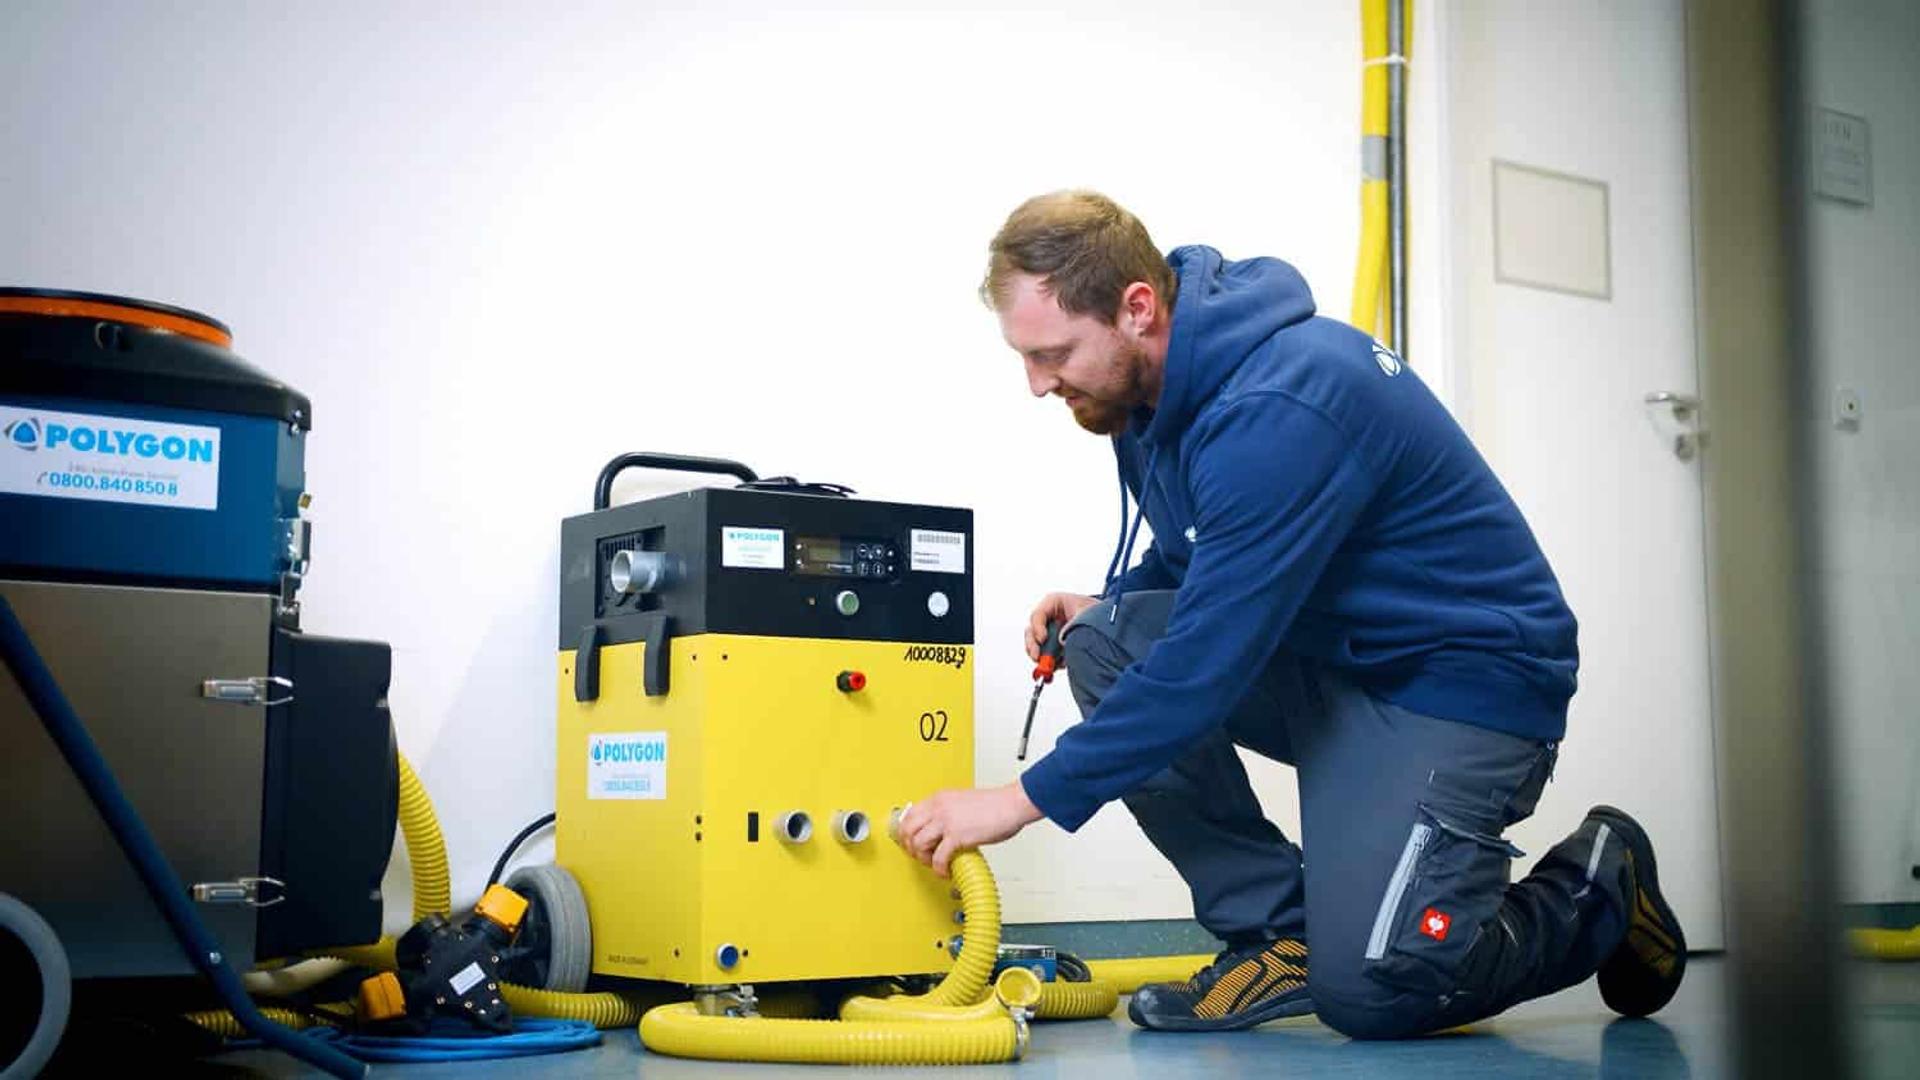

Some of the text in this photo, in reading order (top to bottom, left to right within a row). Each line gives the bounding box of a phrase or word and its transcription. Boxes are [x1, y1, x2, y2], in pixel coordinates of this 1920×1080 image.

[45, 424, 213, 462] POLYGON
[920, 710, 949, 742] 02
[604, 742, 664, 762] POLYGON
